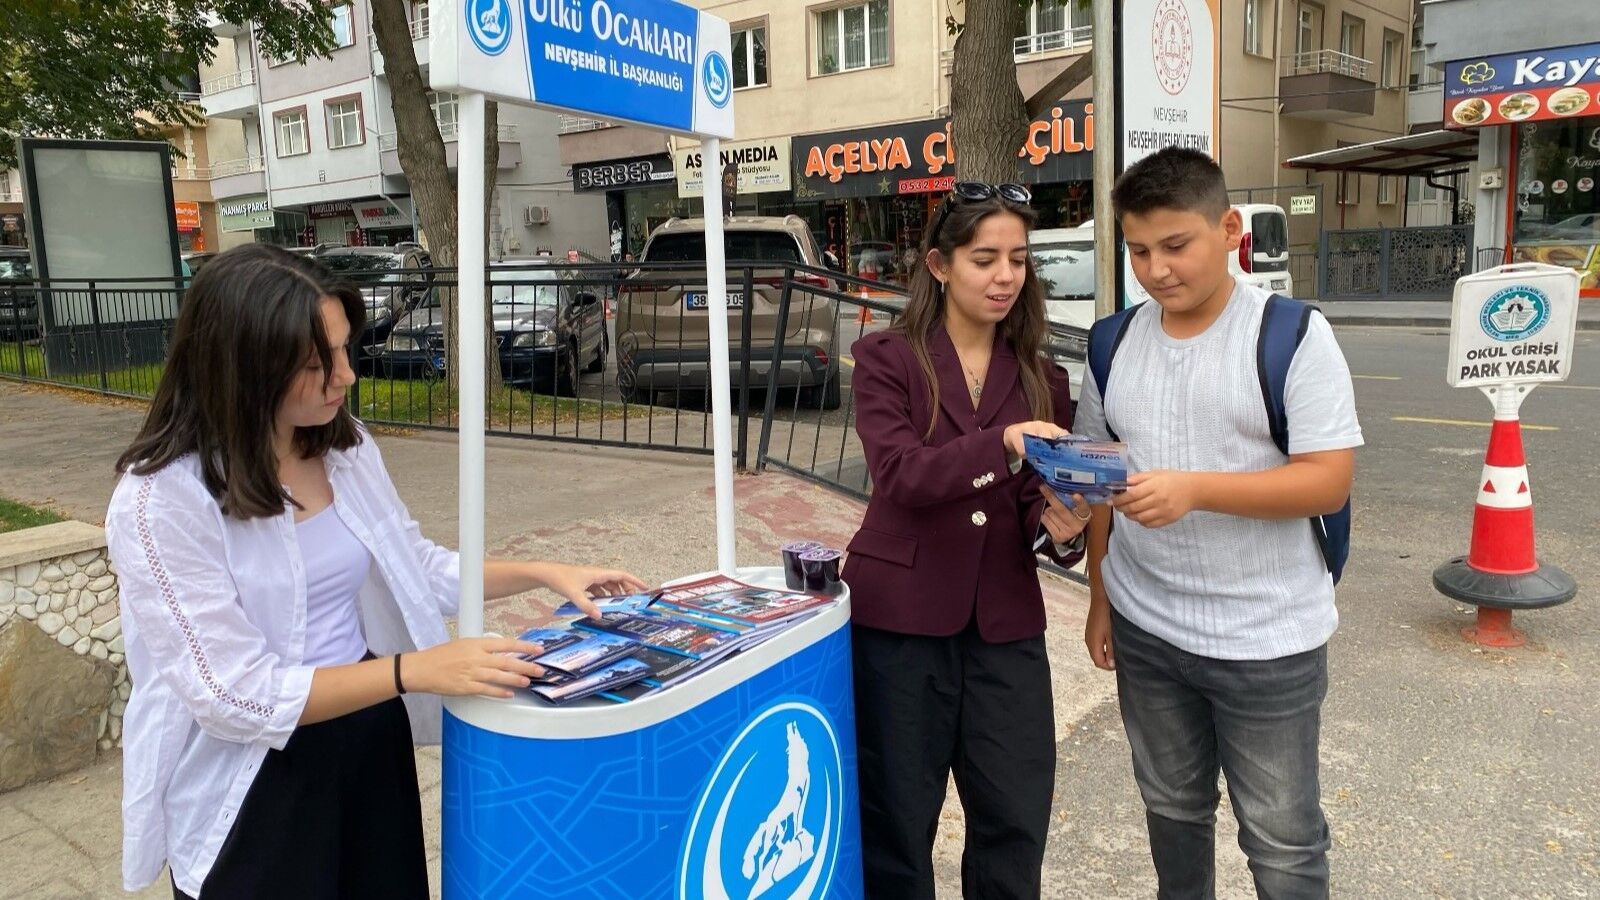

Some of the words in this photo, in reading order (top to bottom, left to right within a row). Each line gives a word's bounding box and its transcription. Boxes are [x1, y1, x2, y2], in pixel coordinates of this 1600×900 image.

[544, 42, 607, 74] NEVŞEHİR
[609, 54, 620, 77] İL
[622, 61, 683, 92] BAŞKANLIĞI
[1512, 56, 1600, 87] Kay
[1153, 107, 1188, 125] NEVŞEHİR
[1128, 128, 1158, 153] NEVŞEHİR
[685, 150, 729, 169] ASN
[733, 145, 778, 164] MEDIA
[805, 136, 912, 183] AÇELYA
[578, 161, 654, 188] BERBER
[247, 200, 268, 213] PARKE
[693, 295, 707, 306] 38
[1466, 346, 1508, 361] OKUL
[1511, 342, 1559, 357] GİRİŞİ
[1460, 362, 1502, 380] PARK
[1505, 359, 1560, 376] YASAK
